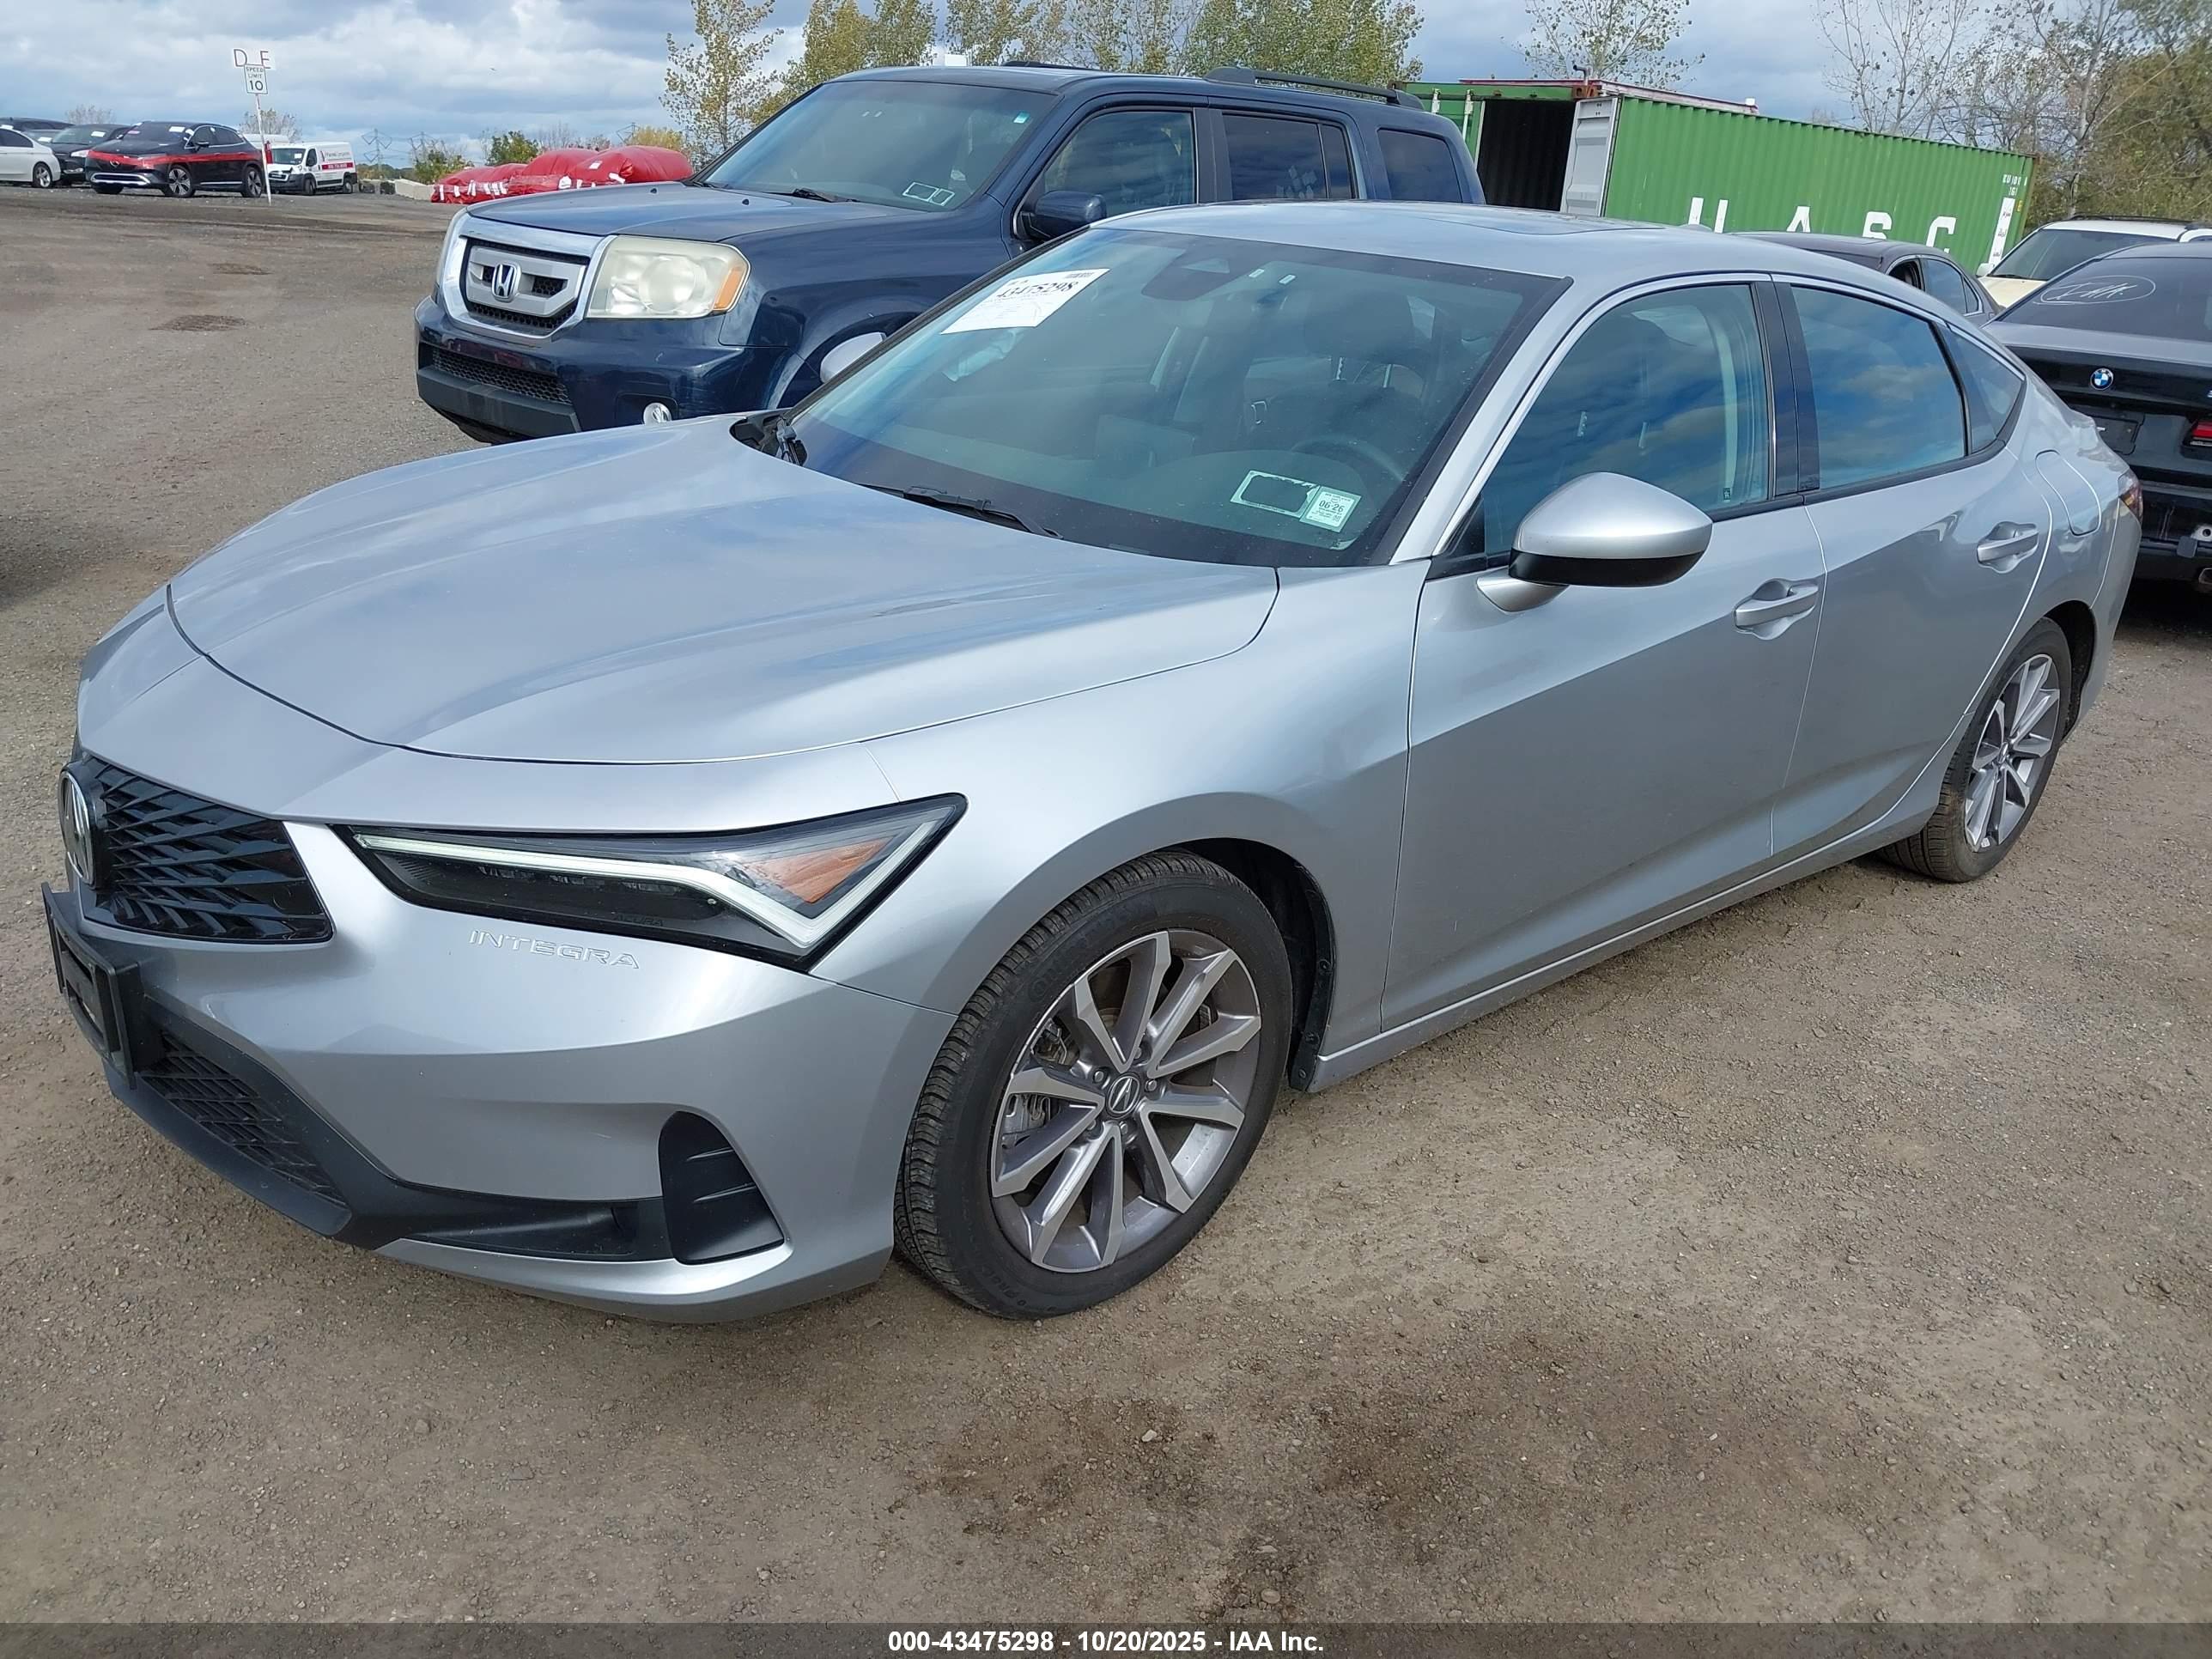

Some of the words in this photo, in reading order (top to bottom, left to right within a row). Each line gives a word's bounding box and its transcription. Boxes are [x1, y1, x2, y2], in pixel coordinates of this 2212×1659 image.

[234, 49, 247, 67] D
[250, 80, 264, 91] 10
[469, 930, 640, 969] INTEGRA
